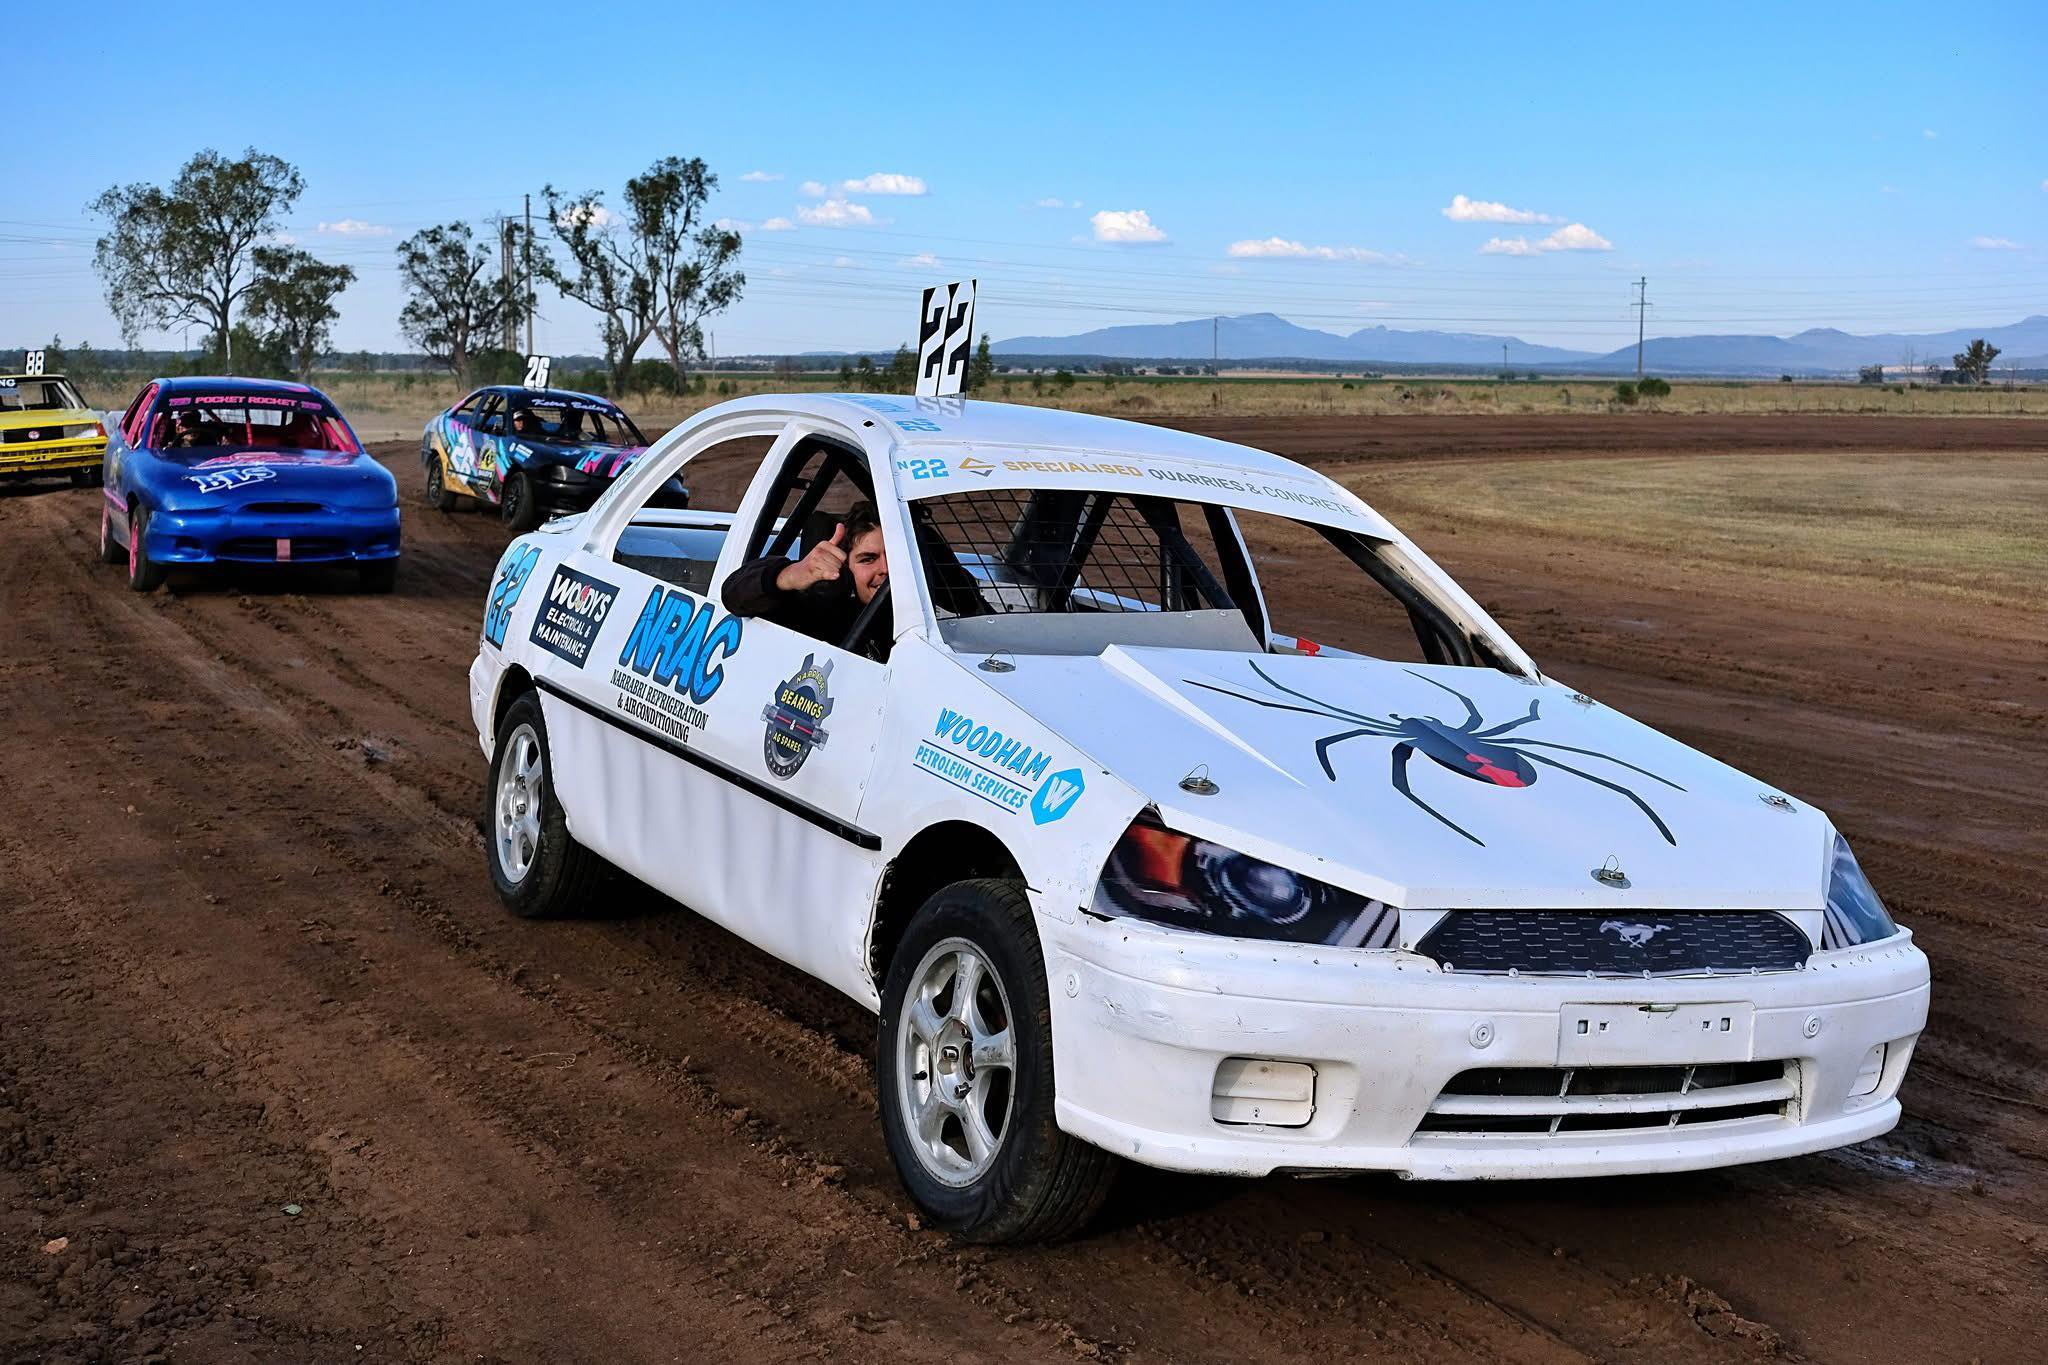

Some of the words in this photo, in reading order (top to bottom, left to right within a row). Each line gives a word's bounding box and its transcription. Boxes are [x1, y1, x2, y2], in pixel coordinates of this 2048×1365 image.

[914, 279, 976, 397] 22
[26, 351, 44, 376] 88
[523, 356, 551, 388] 26
[195, 396, 246, 404] POCKET
[248, 396, 298, 407] ROCKET
[1002, 461, 1144, 477] SPECIALISED
[1147, 468, 1246, 492] QUARRIES
[1247, 483, 1262, 495] &
[1263, 486, 1359, 518] CONCRETE
[549, 573, 612, 623] WOODY'S
[535, 622, 587, 659] MAINTENANCE
[546, 606, 586, 636] ELECTRICAL
[583, 625, 592, 638] &
[618, 583, 744, 706] NRAC
[610, 669, 647, 699] NARRABRI
[644, 685, 710, 731] REFRIGERATION
[616, 692, 624, 709] &
[623, 696, 690, 744] AIRCONDITIONING
[781, 688, 825, 720] BEARINGS
[772, 732, 782, 743] AG
[781, 736, 802, 753] SPARES
[789, 719, 797, 731] &
[934, 707, 1052, 782] WOODHAM
[914, 744, 973, 785] PETROLEUM
[970, 772, 1029, 809] SERVICES
